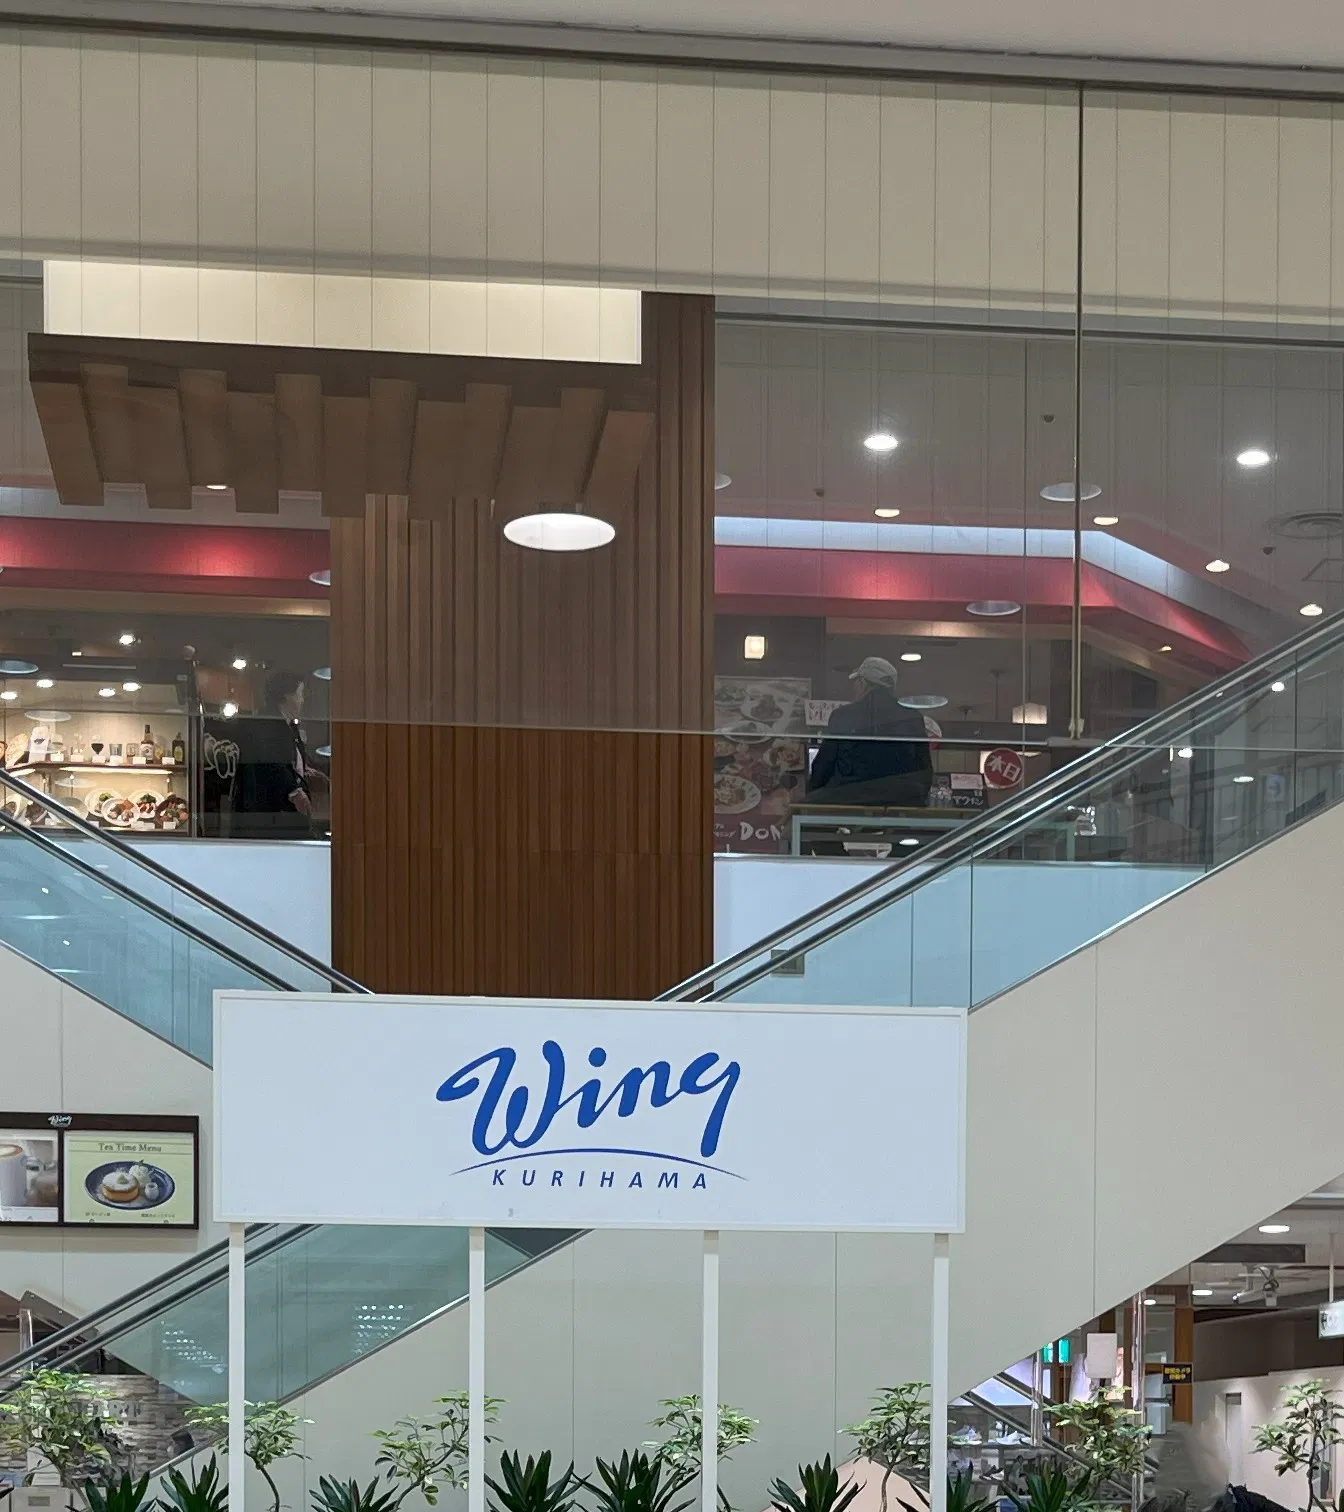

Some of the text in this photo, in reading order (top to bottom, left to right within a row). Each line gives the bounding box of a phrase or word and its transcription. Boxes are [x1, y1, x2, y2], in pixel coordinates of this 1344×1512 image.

[436, 1040, 740, 1158] Wing
[98, 1143, 162, 1153] Tea Time Menu
[492, 1169, 707, 1189] KURIHAMA
